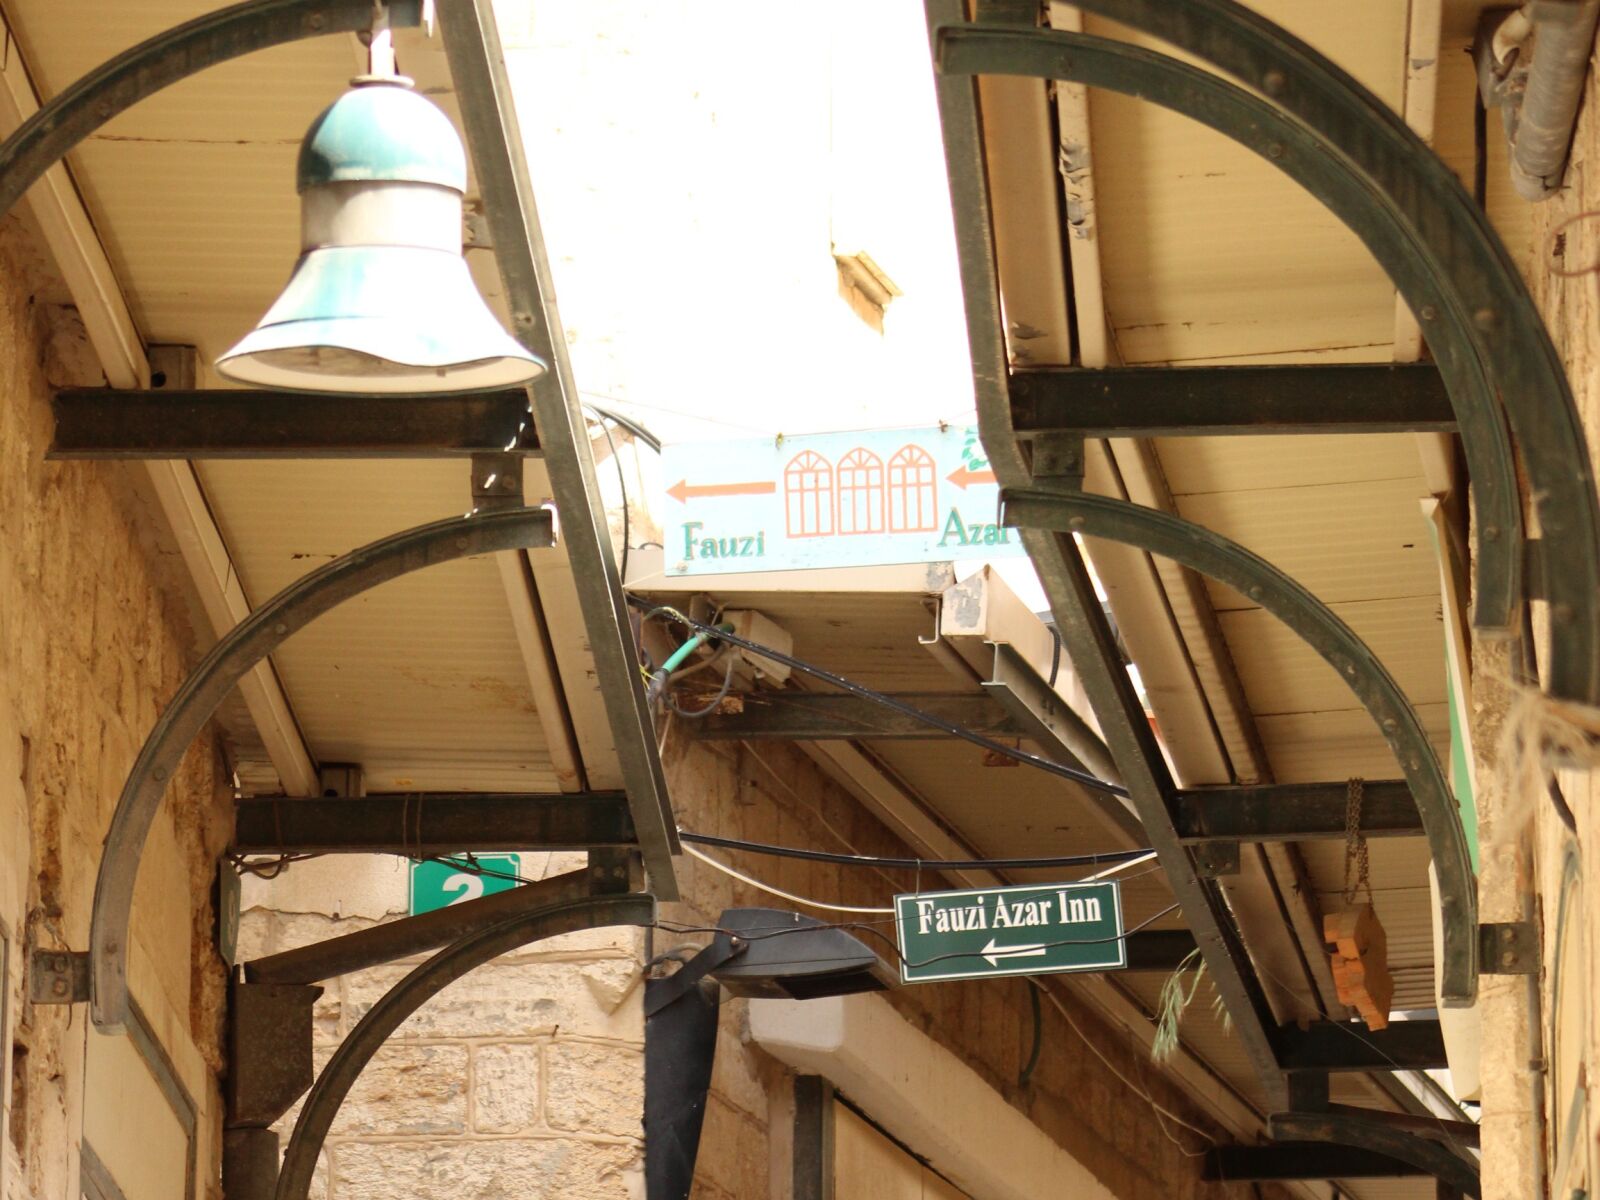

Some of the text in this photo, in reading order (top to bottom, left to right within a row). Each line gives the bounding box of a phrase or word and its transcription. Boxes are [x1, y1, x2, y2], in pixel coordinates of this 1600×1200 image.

[681, 521, 765, 560] Fauzi
[916, 890, 1102, 934] Fauzi Azar Inn
